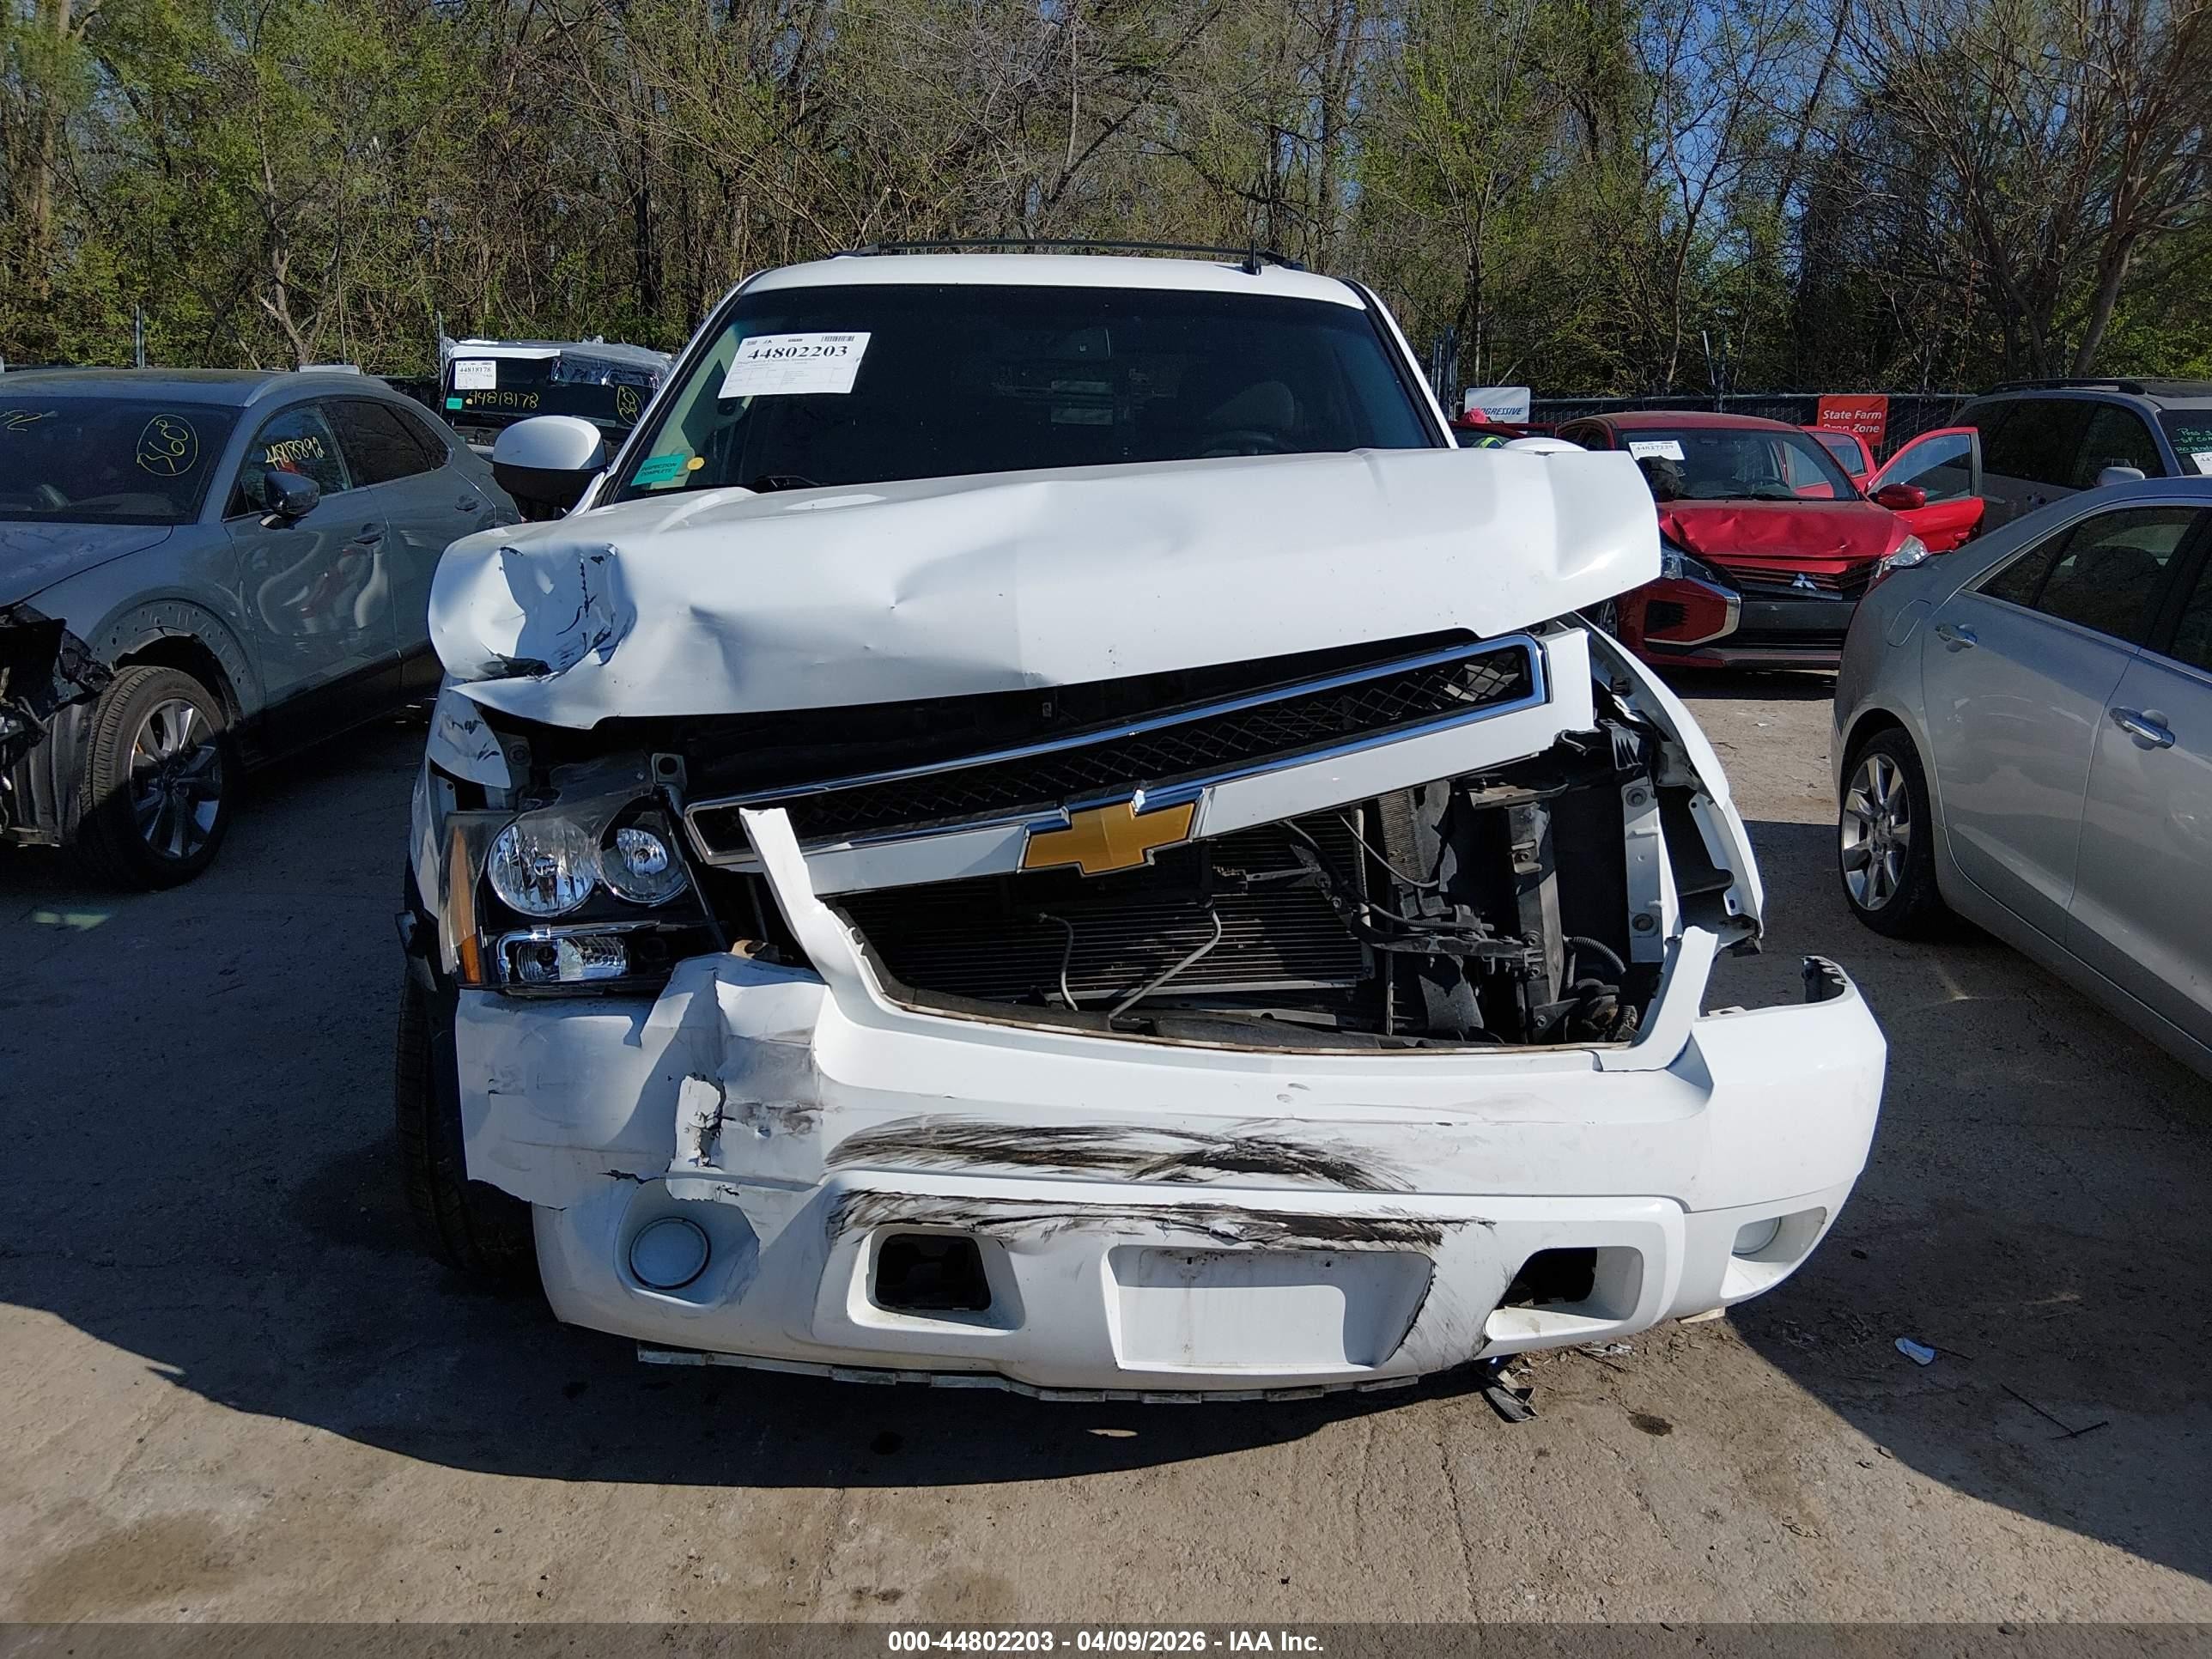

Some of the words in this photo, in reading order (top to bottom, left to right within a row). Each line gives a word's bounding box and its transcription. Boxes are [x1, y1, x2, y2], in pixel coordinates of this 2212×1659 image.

[746, 345, 848, 360] 44802203
[1480, 407, 1524, 416] OGRESSIVE
[1822, 410, 1852, 420] State
[1854, 410, 1882, 420] Farm
[1852, 422, 1881, 433] Zone
[264, 436, 325, 471] 44818892
